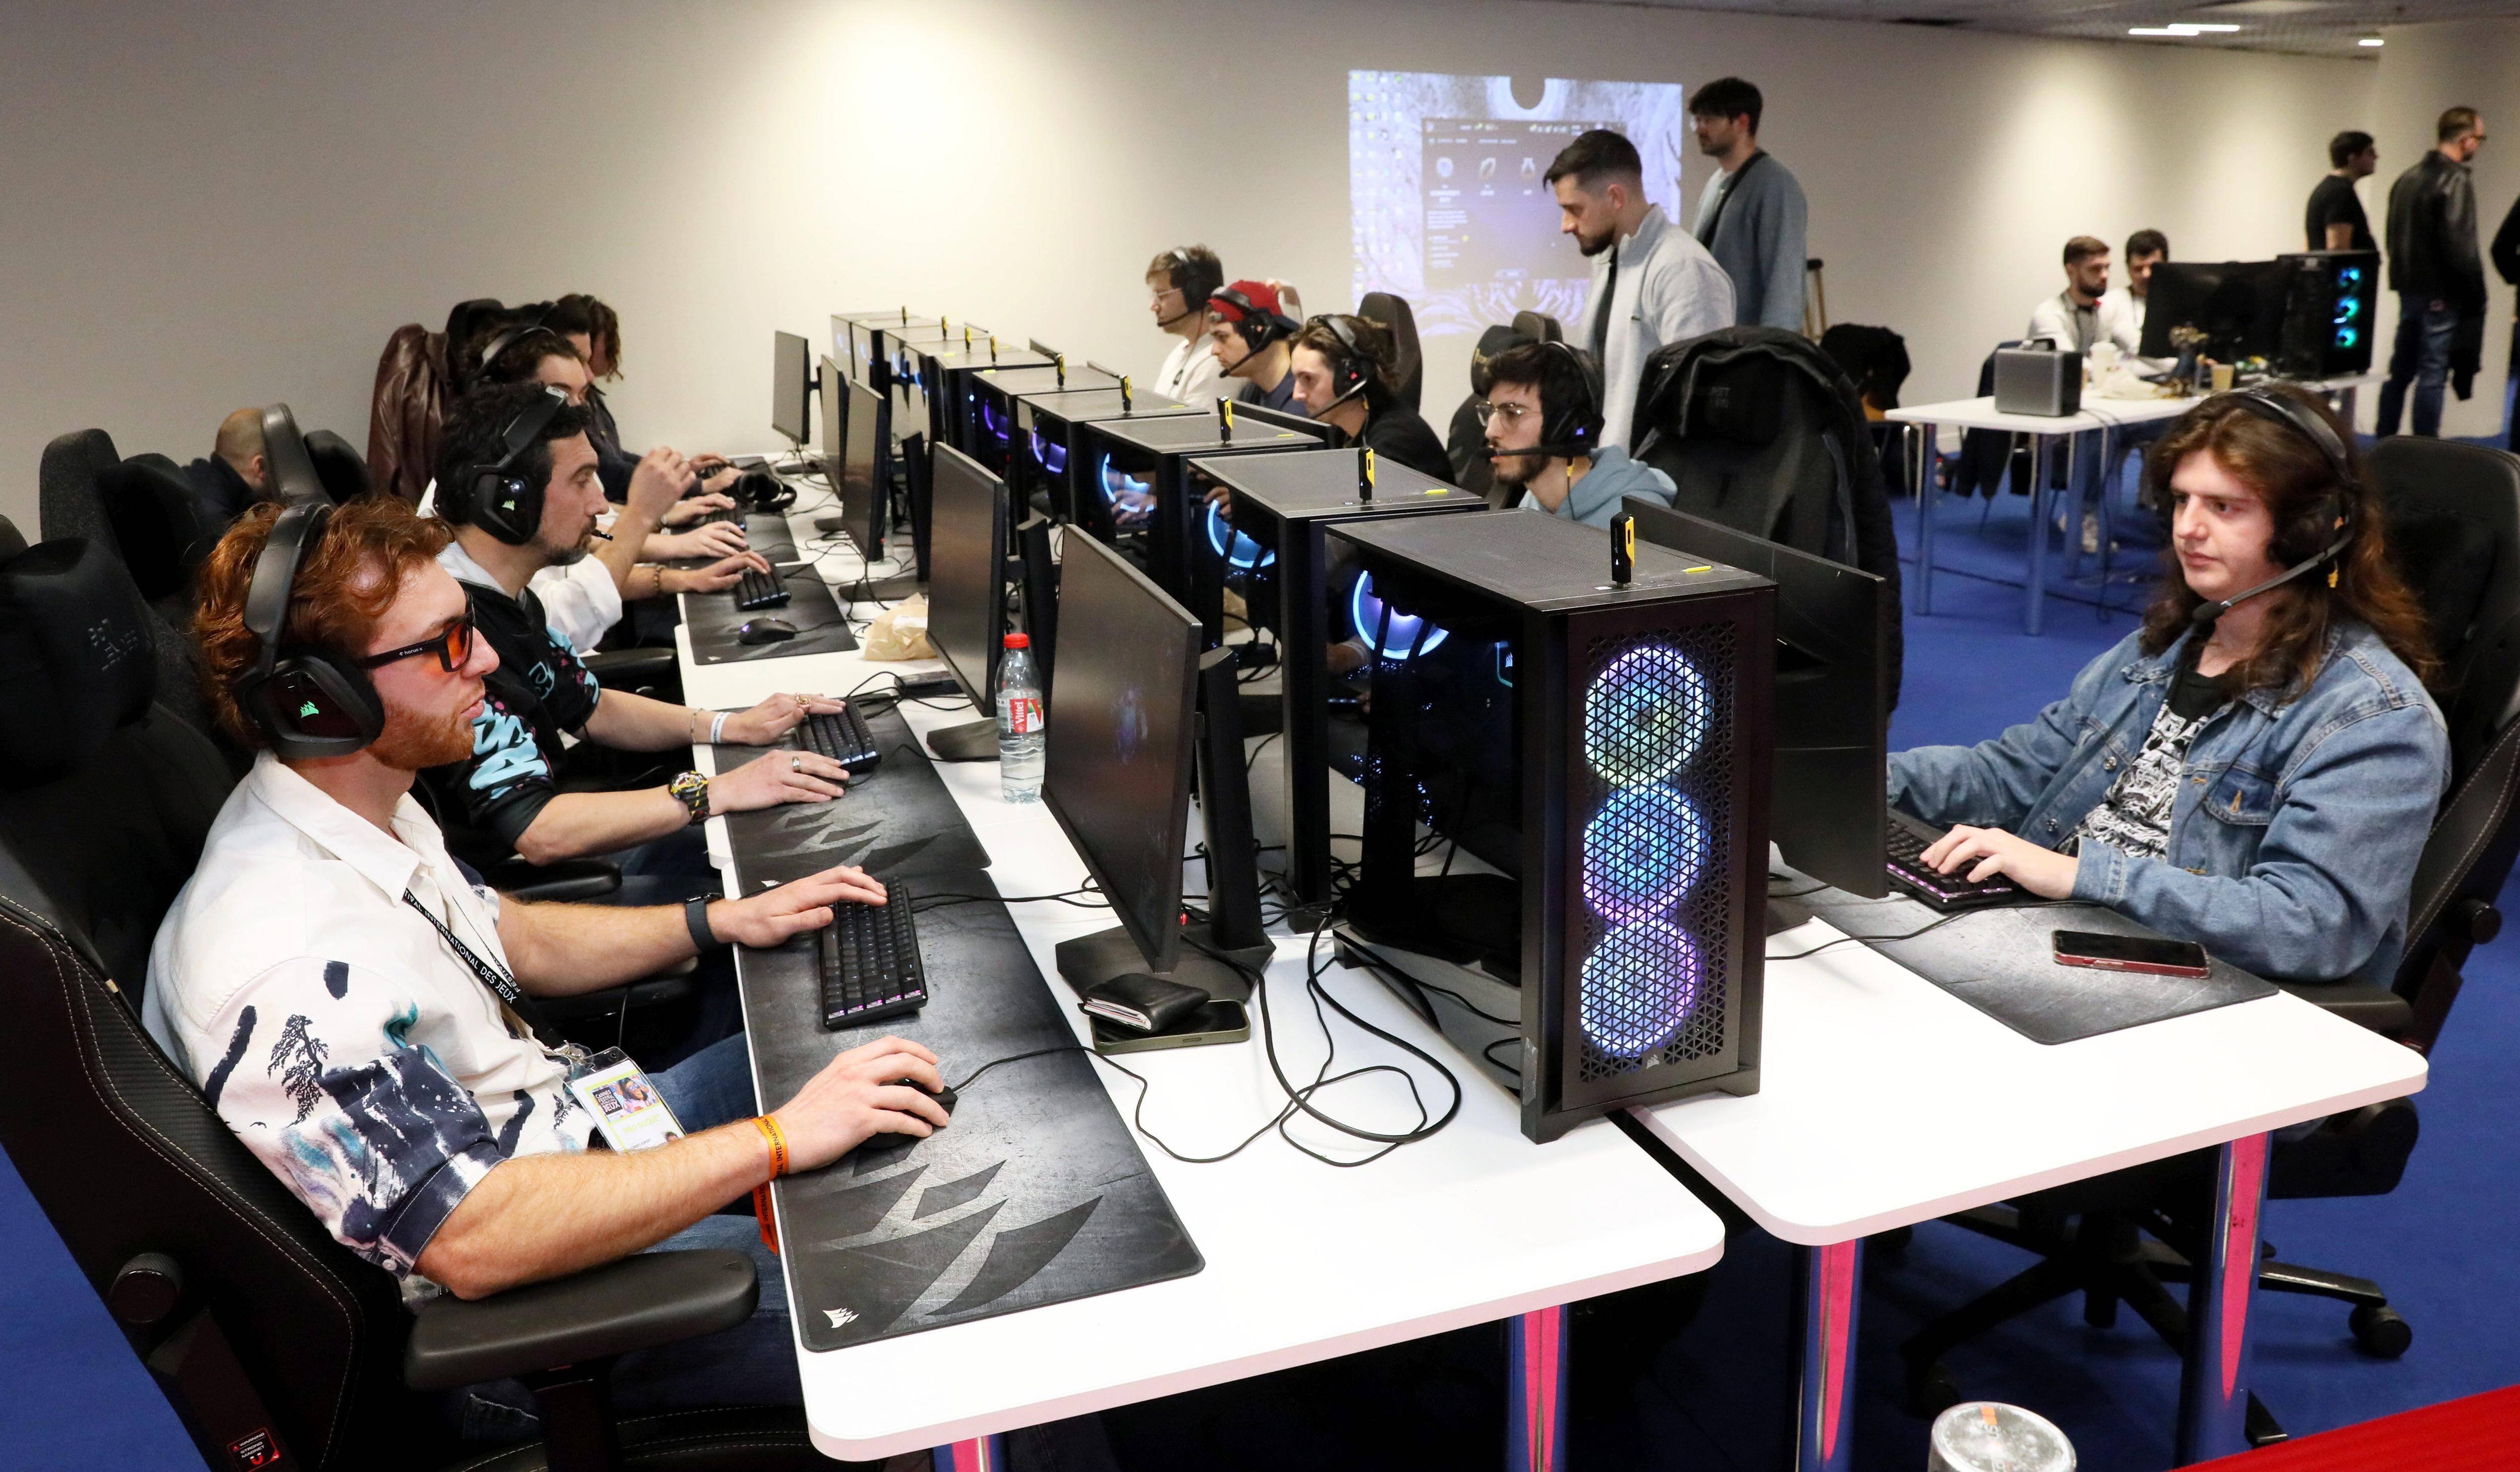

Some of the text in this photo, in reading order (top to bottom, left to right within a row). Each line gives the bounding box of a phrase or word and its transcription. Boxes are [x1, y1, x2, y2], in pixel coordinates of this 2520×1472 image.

[1015, 702, 1024, 724] Vittel
[424, 911, 478, 969] INTERNATIONAL
[480, 966, 496, 984] DES
[495, 981, 517, 1004] JEUX
[595, 1089, 611, 1098] CANNES
[598, 1094, 615, 1103] FESTIVAL
[602, 1100, 621, 1112] JEUX
[763, 1118, 783, 1161] INTERNATIONAL
[239, 1432, 265, 1446] WARNING
[240, 1442, 263, 1454] STRONG
[242, 1445, 265, 1458] MAGNET
